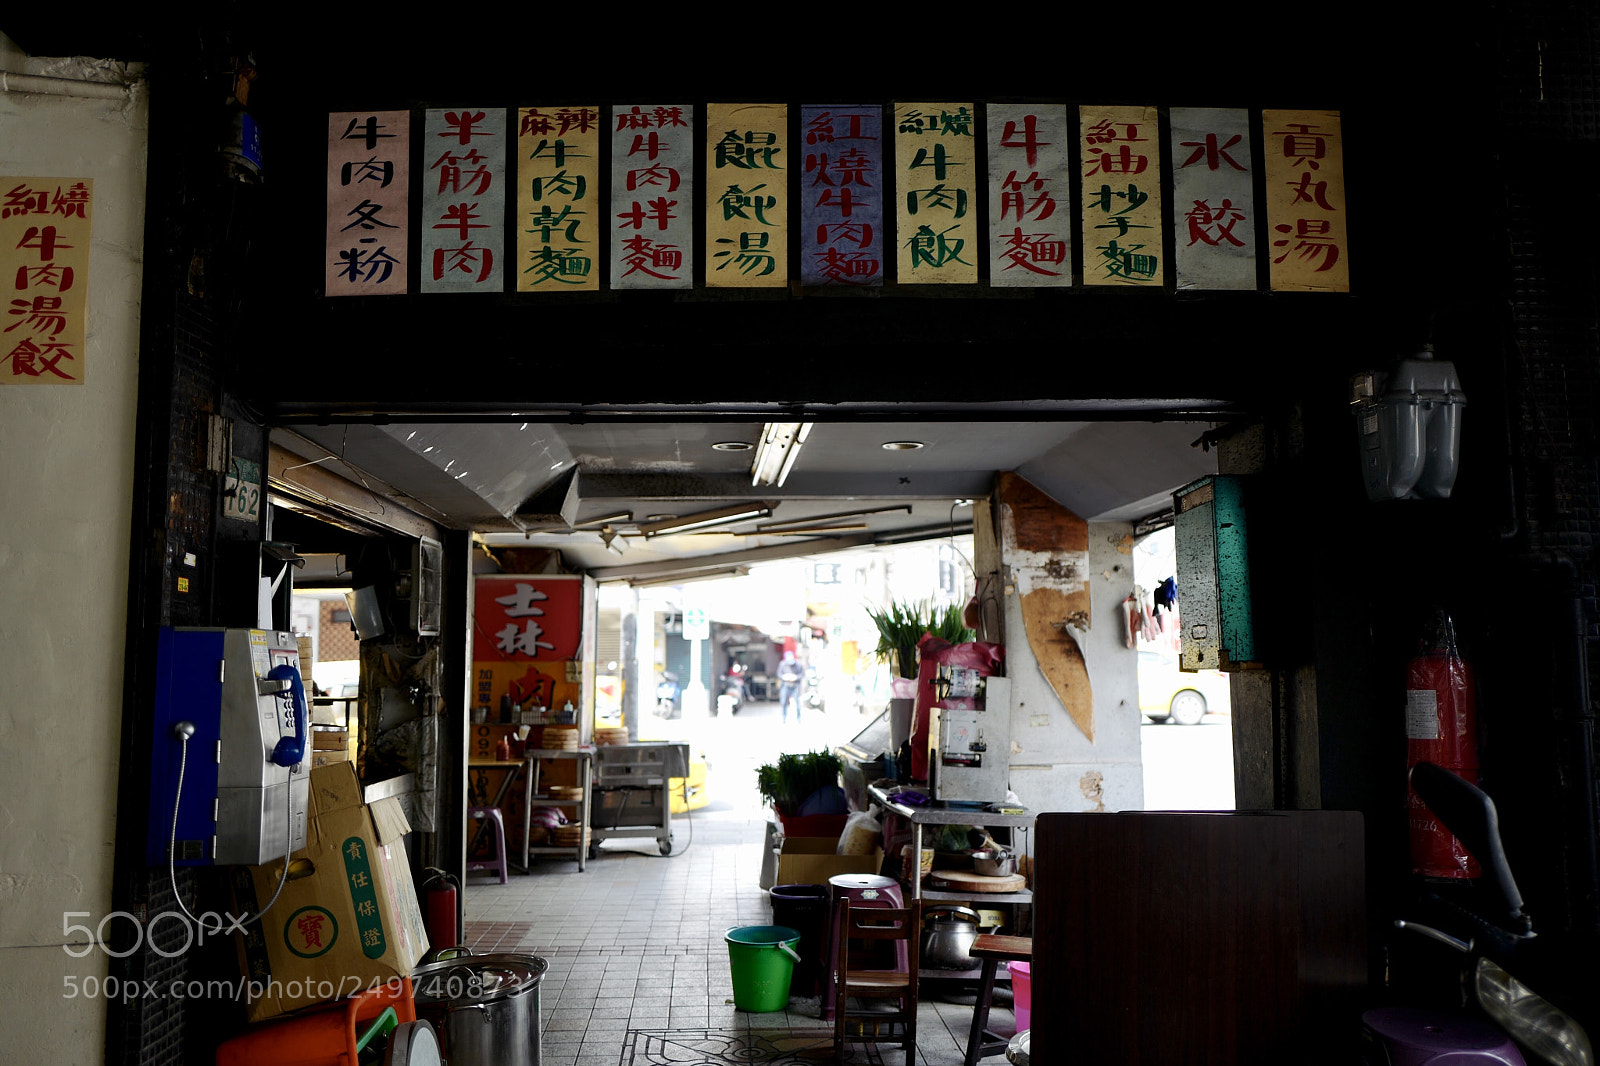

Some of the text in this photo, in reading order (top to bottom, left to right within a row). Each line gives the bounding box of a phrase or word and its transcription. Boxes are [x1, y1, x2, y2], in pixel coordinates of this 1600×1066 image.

[519, 108, 600, 137] 麻辣
[616, 106, 688, 132] 麻辣
[898, 106, 975, 136] 紅燒
[1, 182, 90, 219] 紅燒
[333, 116, 400, 284] 牛肉冬粉
[430, 111, 496, 283] 半筋半肉
[616, 132, 683, 280] 牛肉拌麵
[713, 129, 785, 277] 餛飩湯
[806, 111, 880, 286] 紅燒牛肉麵
[903, 143, 974, 269] 牛肉飯
[998, 114, 1066, 277] 牛筋麵
[1179, 132, 1248, 248] 水餃
[1272, 123, 1340, 273] 貢丸湯
[0, 225, 77, 380] 牛肉湯餃
[228, 483, 259, 516] 162
[495, 582, 556, 658] 士林
[297, 914, 325, 950] 寶
[346, 841, 382, 947] 責任保證
